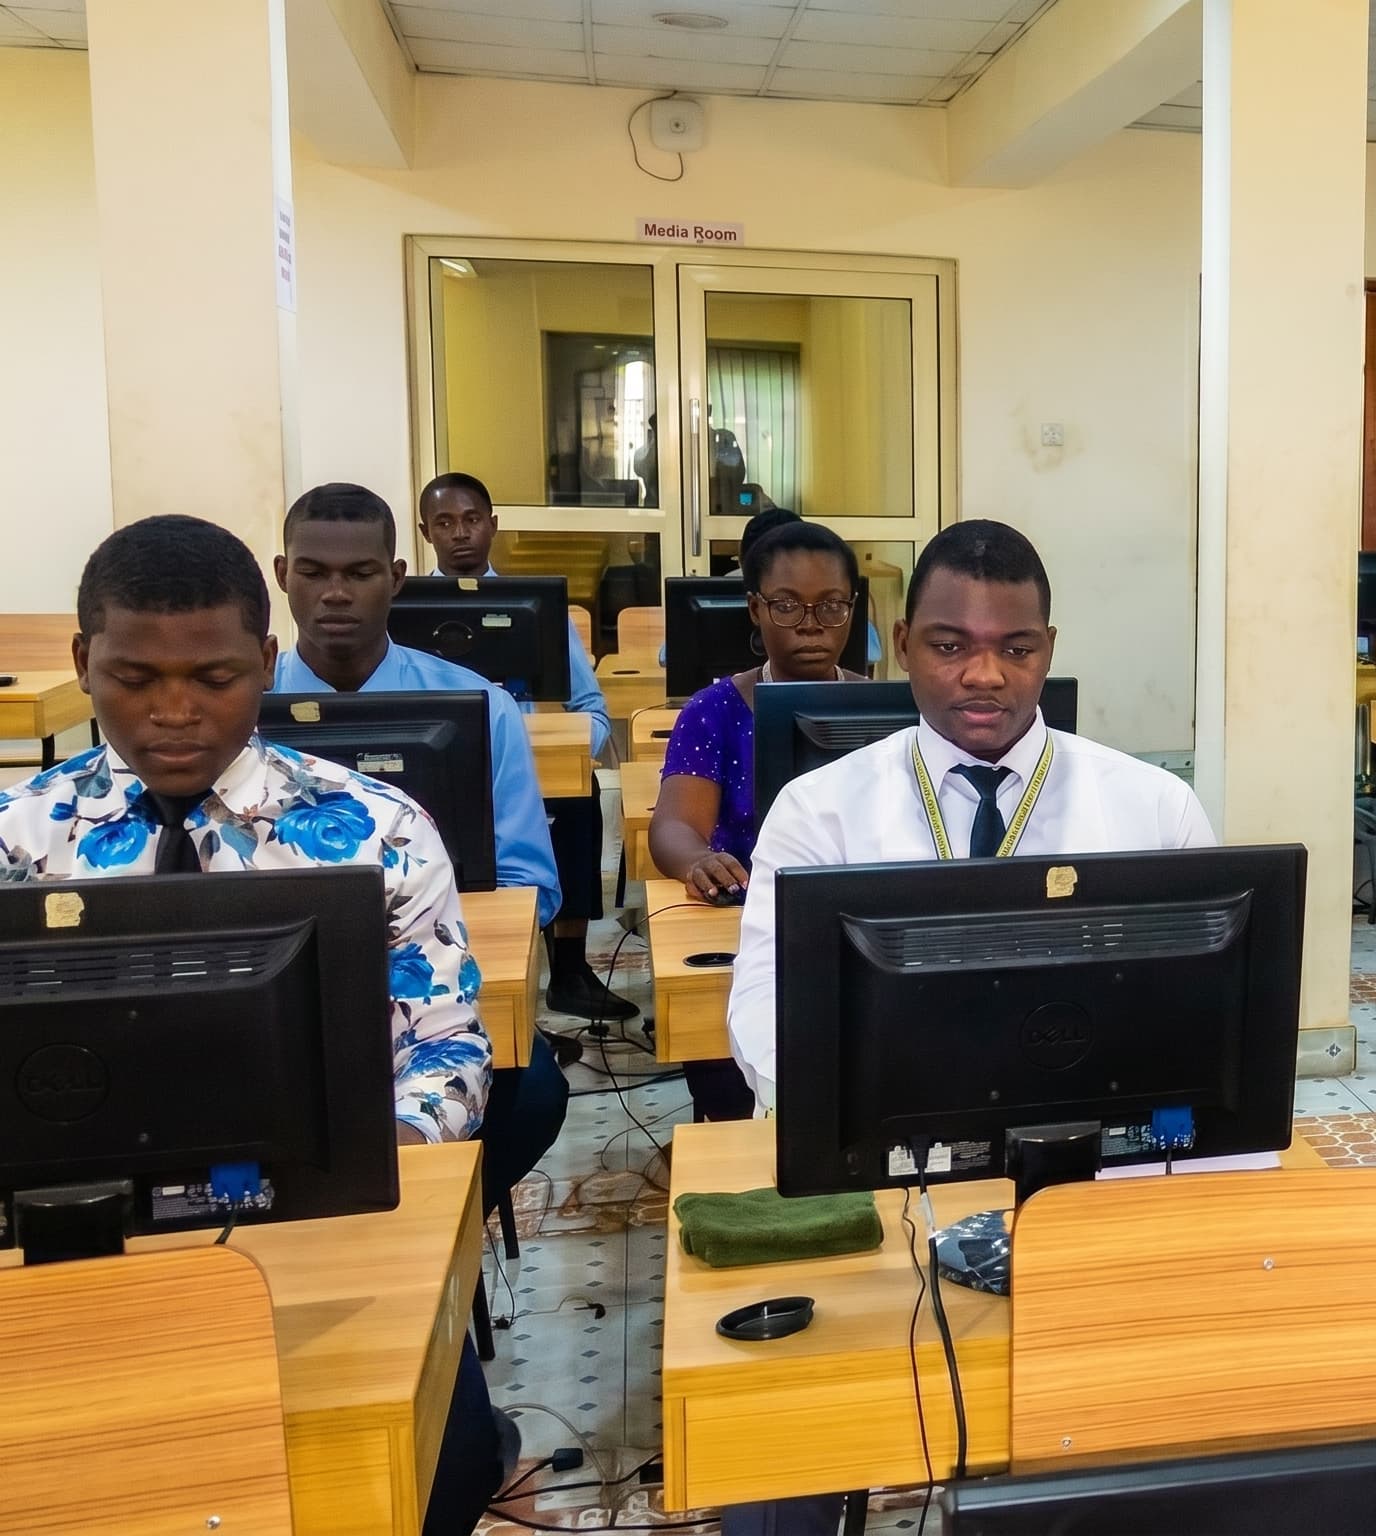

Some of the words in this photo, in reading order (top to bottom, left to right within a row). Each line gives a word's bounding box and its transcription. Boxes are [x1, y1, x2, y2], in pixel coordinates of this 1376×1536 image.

[644, 223, 689, 238] Media
[693, 226, 737, 241] Room
[1027, 1024, 1088, 1047] DELL
